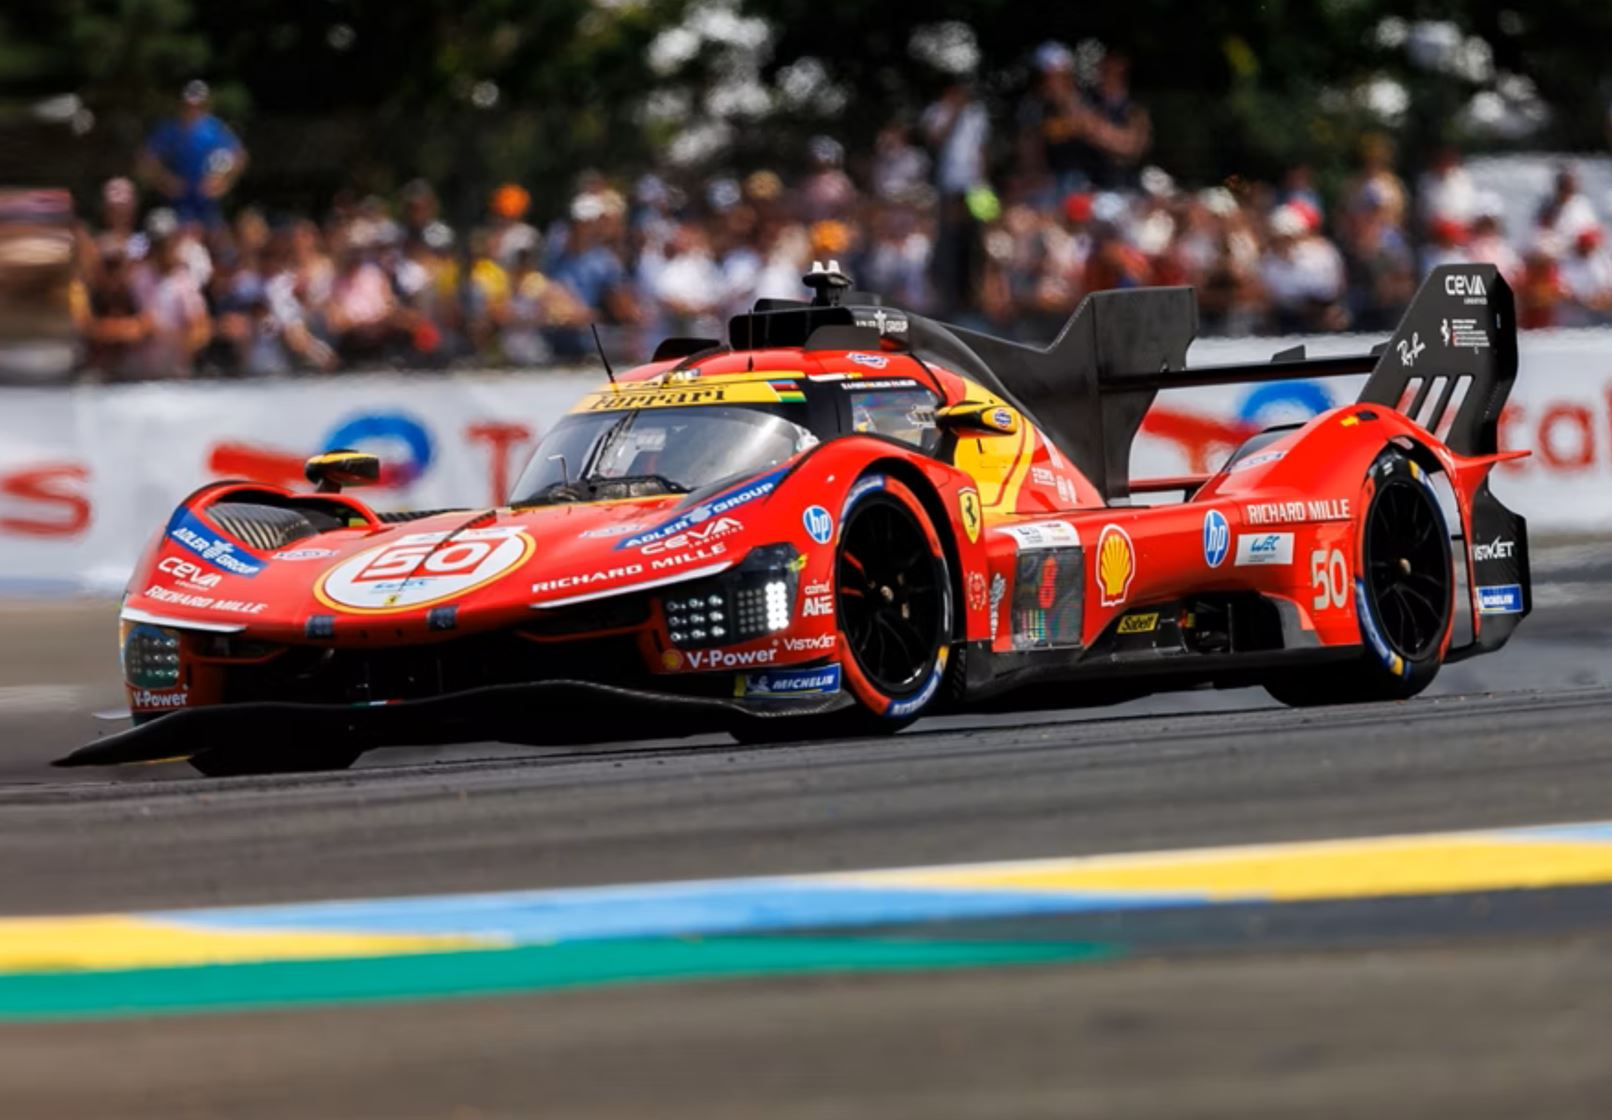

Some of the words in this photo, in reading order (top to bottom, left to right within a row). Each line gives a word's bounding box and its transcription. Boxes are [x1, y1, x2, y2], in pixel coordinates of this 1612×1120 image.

[1445, 275, 1487, 296] CEVA
[589, 389, 725, 410] Ferrari
[624, 517, 687, 547] ADLER
[713, 482, 774, 514] GROUP
[806, 507, 831, 545] hp
[1247, 501, 1305, 525] RICHARD
[1307, 499, 1351, 521] MILLE
[641, 517, 743, 555] CEVA
[1206, 510, 1227, 565] hp
[158, 556, 222, 588] CEVA
[360, 542, 493, 578] 50
[531, 563, 643, 593] RICHARD
[652, 542, 727, 570] MILLE
[1311, 549, 1348, 611] 50
[145, 586, 212, 609] RICHARD
[211, 598, 269, 614] MILLE
[686, 647, 778, 669] V-Power
[132, 690, 188, 707] V-Power
[772, 674, 835, 691] MICHELIN
